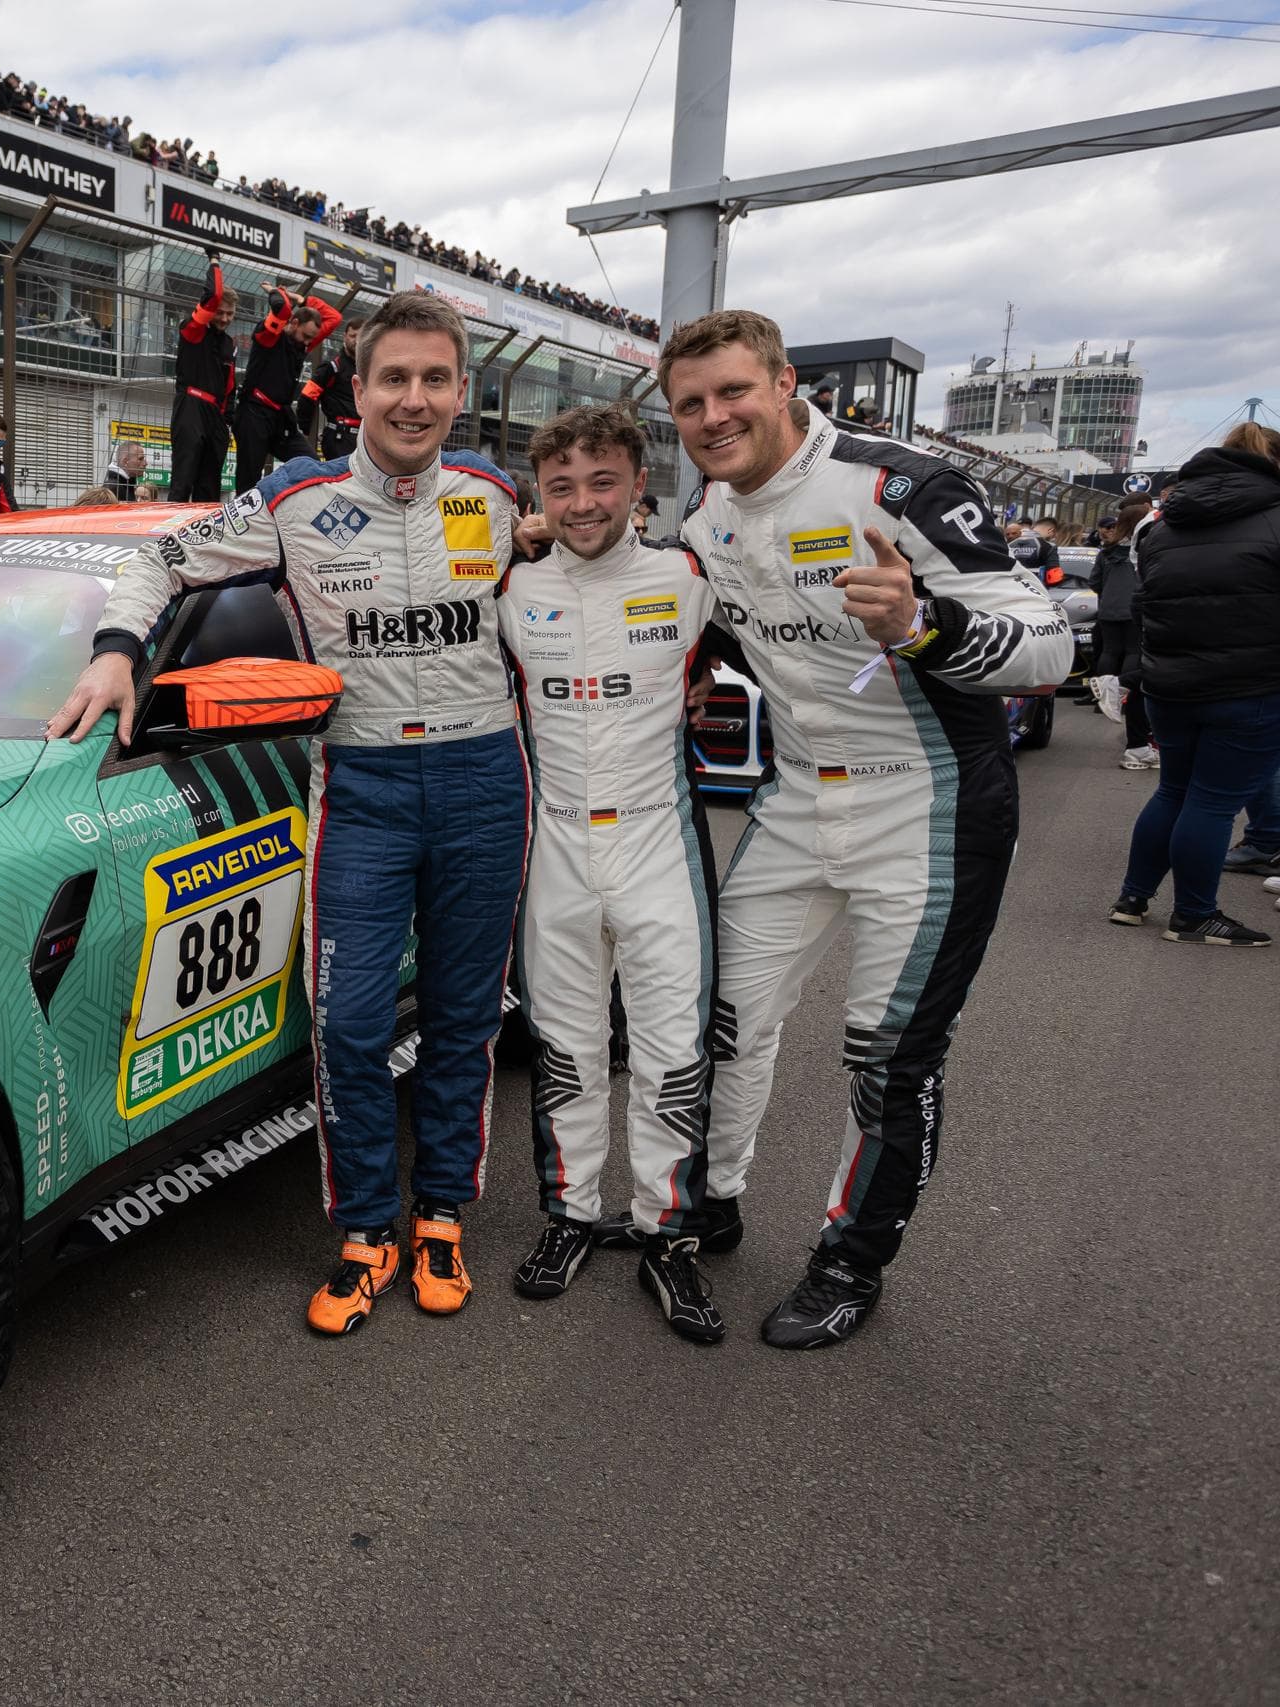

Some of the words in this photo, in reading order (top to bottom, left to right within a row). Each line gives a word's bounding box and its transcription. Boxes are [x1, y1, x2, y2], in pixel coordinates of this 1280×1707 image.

[191, 208, 274, 250] MANTHEY
[889, 482, 906, 495] 21
[442, 499, 487, 517] ADAC
[797, 538, 845, 551] RAVENOL
[19, 557, 114, 575] SIMULATOR
[334, 566, 371, 574] Motorsport
[455, 563, 495, 576] PIRELLI
[320, 577, 373, 594] HAKRO
[794, 569, 831, 589] H&R
[631, 603, 672, 615] RAVENOL
[345, 604, 443, 651] H&R
[527, 630, 572, 640] Motorsport
[627, 627, 662, 646] H&R
[348, 650, 373, 659] Das
[375, 647, 442, 659] Fahrwerk!
[606, 696, 654, 711] PROGRAM
[427, 725, 440, 734] M.
[441, 720, 474, 732] SCHREY
[850, 765, 877, 777] MAX
[879, 762, 914, 775] PARTL
[96, 783, 202, 829] team.partl
[544, 804, 579, 819] stand21
[626, 800, 674, 817] WISKIRCHEN
[111, 832, 149, 851] follow
[151, 825, 171, 840] us,
[170, 819, 180, 834] if
[181, 816, 203, 833] you
[171, 834, 291, 896] RAVENOL
[175, 896, 262, 1010] 888
[317, 937, 337, 1000] Bonk
[176, 994, 271, 1077] DEKRA
[34, 1022, 48, 1072] noun
[317, 1005, 342, 1125] Motorsport
[56, 1132, 69, 1165] am
[91, 1162, 214, 1244] HOFOR
[201, 1100, 316, 1179] RACING
